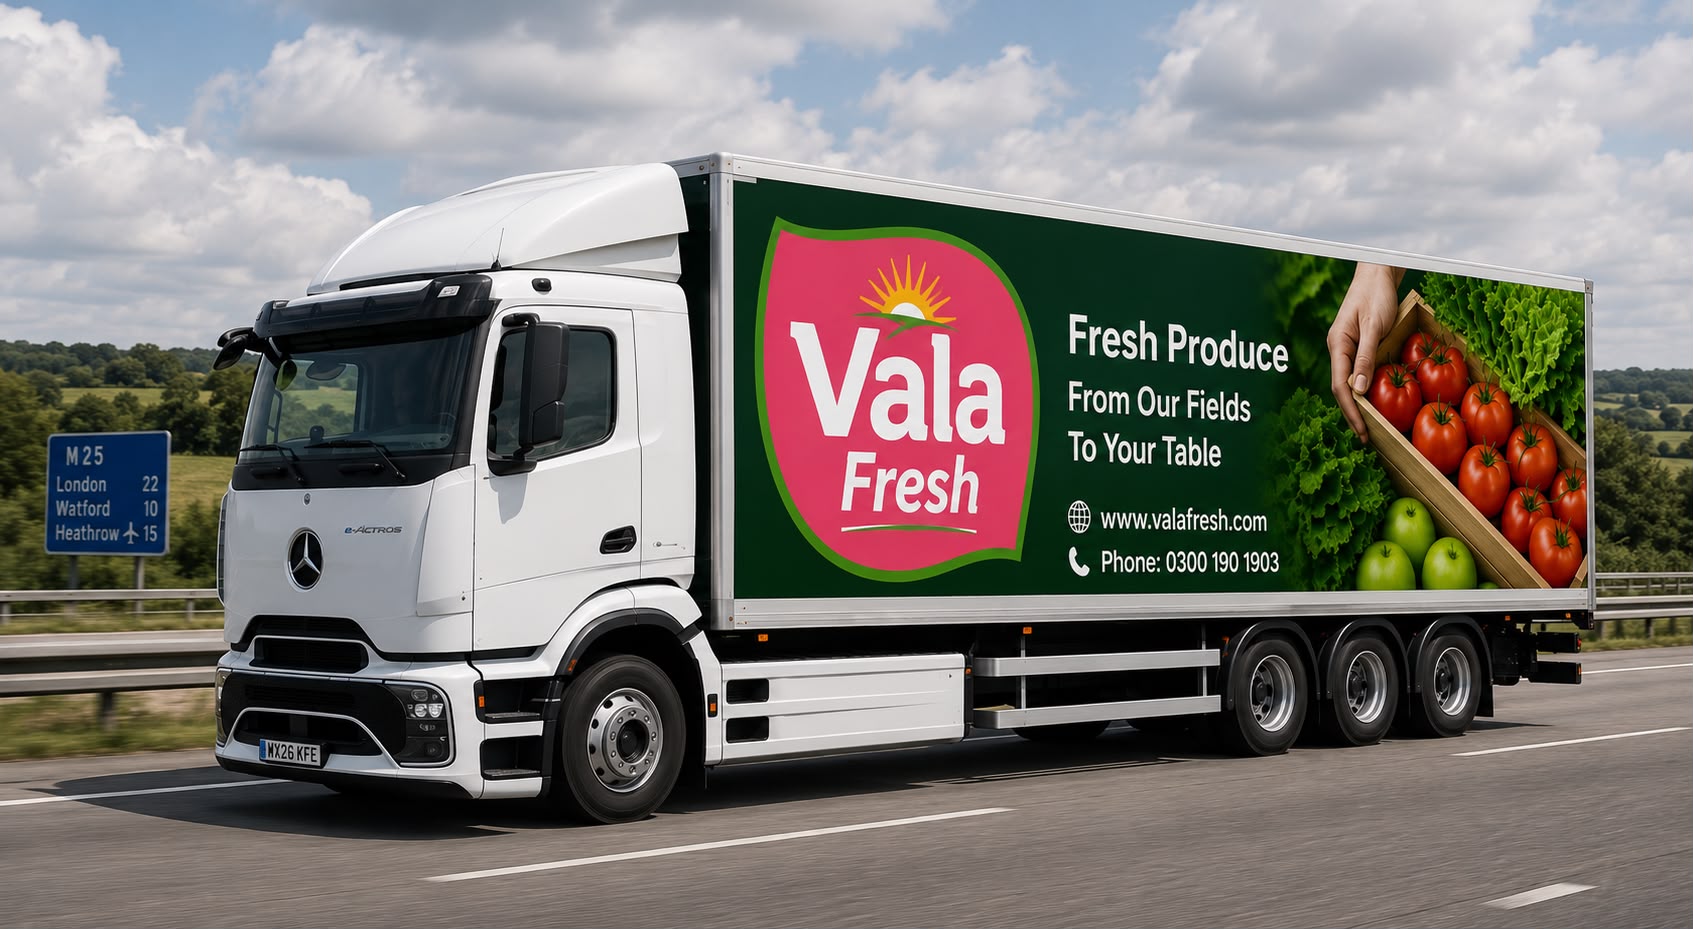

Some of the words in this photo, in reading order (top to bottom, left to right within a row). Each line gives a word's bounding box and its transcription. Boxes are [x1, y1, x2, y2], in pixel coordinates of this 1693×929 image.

[1069, 313, 1158, 362] Fresh
[1168, 323, 1289, 373] Produce
[789, 320, 1007, 445] Vala
[1068, 380, 1130, 415] From
[1137, 385, 1181, 418] Our
[1187, 389, 1251, 423] Fields
[1067, 430, 1097, 463] To
[1102, 432, 1157, 465] Your
[1161, 435, 1222, 468] Table
[56, 475, 107, 493] London
[142, 475, 159, 492] 22
[840, 450, 980, 514] Fresh
[55, 499, 111, 517] Watford
[143, 499, 159, 517] 10
[1100, 507, 1268, 532] www.valafresh.com
[55, 523, 120, 542] Heathrow
[143, 524, 158, 542] 15
[1101, 549, 1161, 573] Phone:
[1165, 550, 1208, 573] 0300
[1211, 551, 1239, 573] 190
[1243, 551, 1280, 573] 1903
[297, 746, 317, 762] KFE
